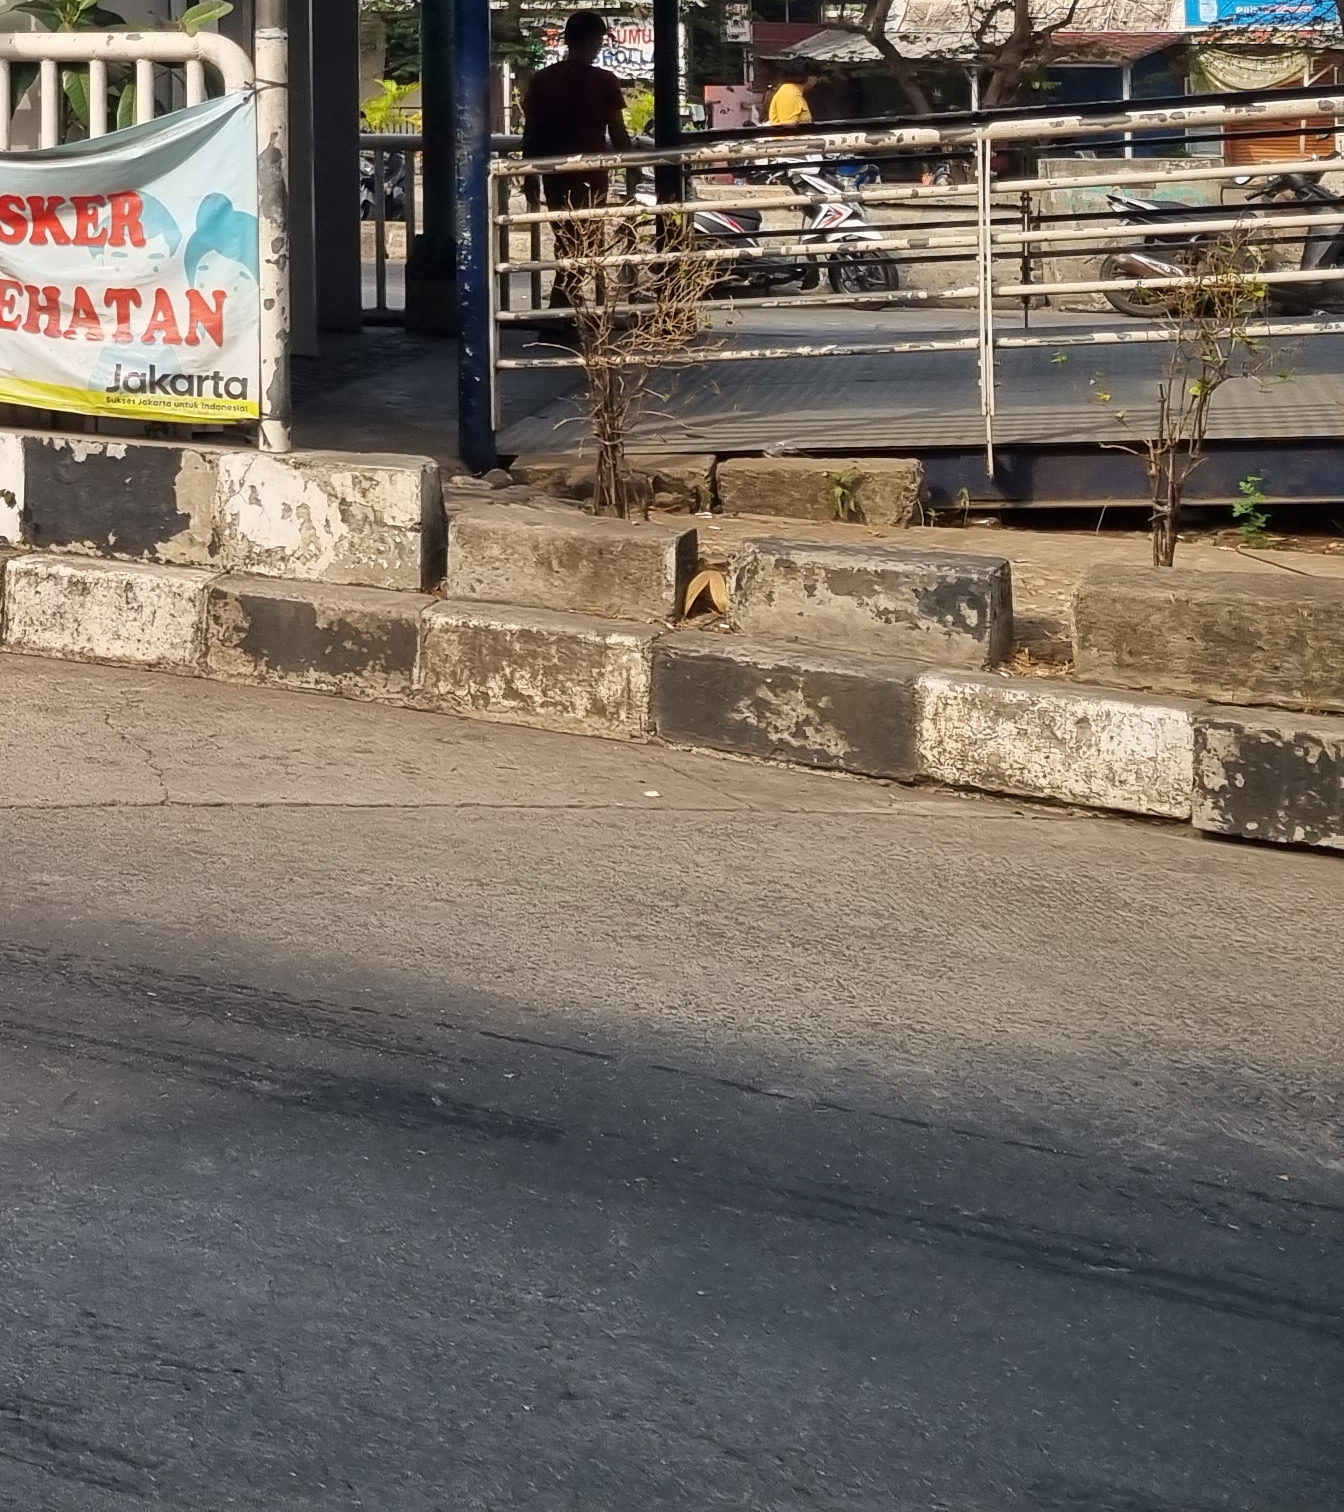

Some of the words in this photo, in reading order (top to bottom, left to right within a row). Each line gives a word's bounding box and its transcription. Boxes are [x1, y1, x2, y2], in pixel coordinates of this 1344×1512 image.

[105, 363, 249, 401] Jakarta
[106, 396, 136, 405] Sukses
[138, 399, 172, 408] Jakarta
